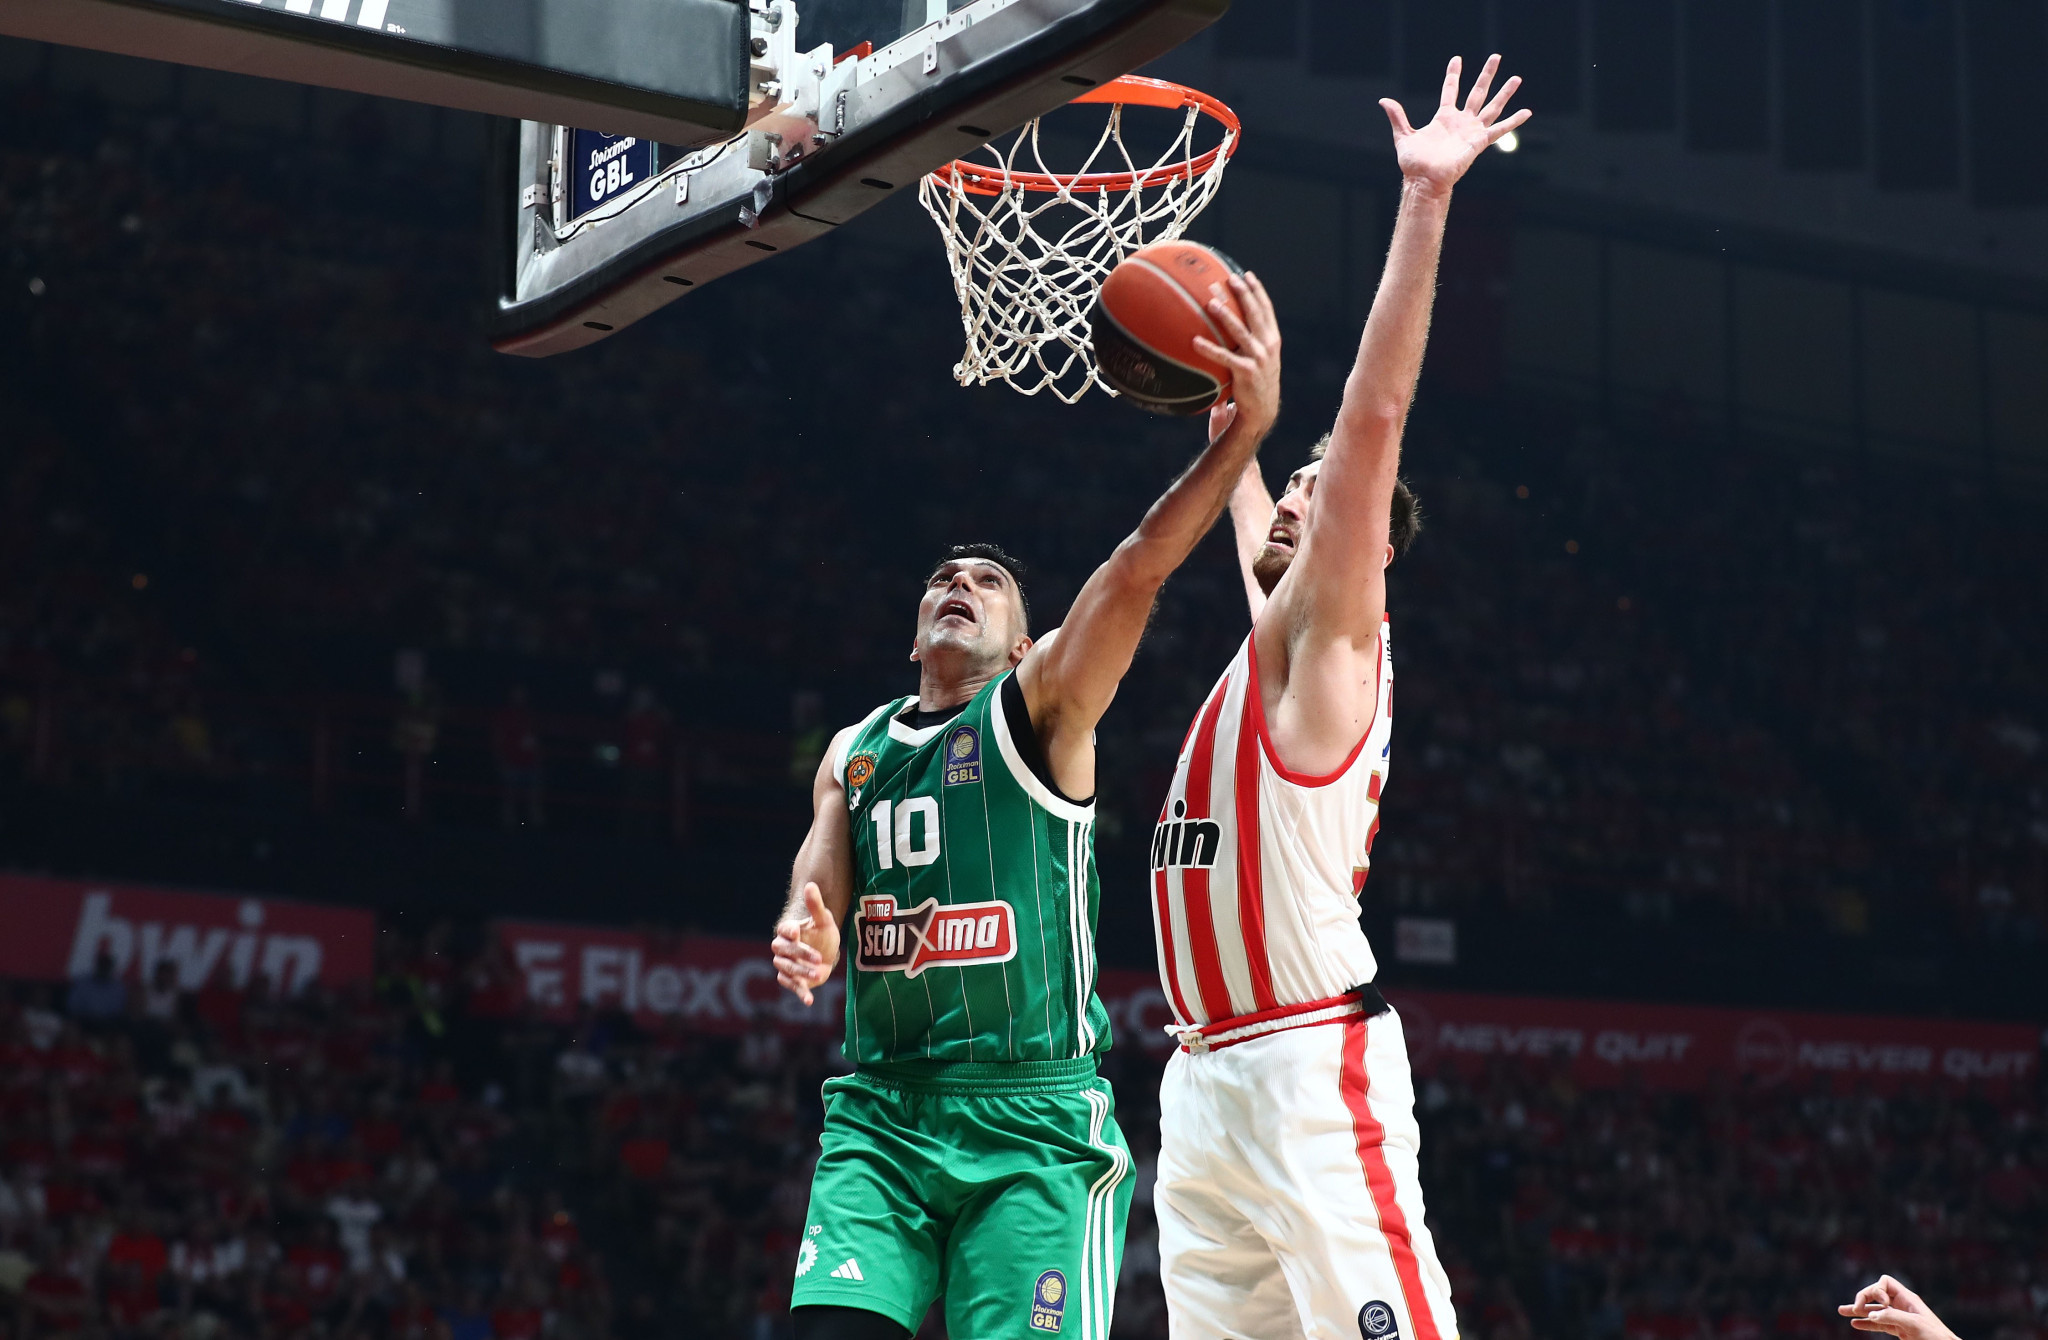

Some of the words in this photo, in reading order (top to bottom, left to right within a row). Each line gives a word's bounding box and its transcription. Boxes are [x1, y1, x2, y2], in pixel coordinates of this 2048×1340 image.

[590, 154, 634, 201] GBL
[947, 768, 978, 783] GBL
[870, 796, 941, 869] 10
[1798, 1042, 1933, 1074] NEVER
[808, 1224, 822, 1237] bp
[1033, 1313, 1059, 1330] GBL
